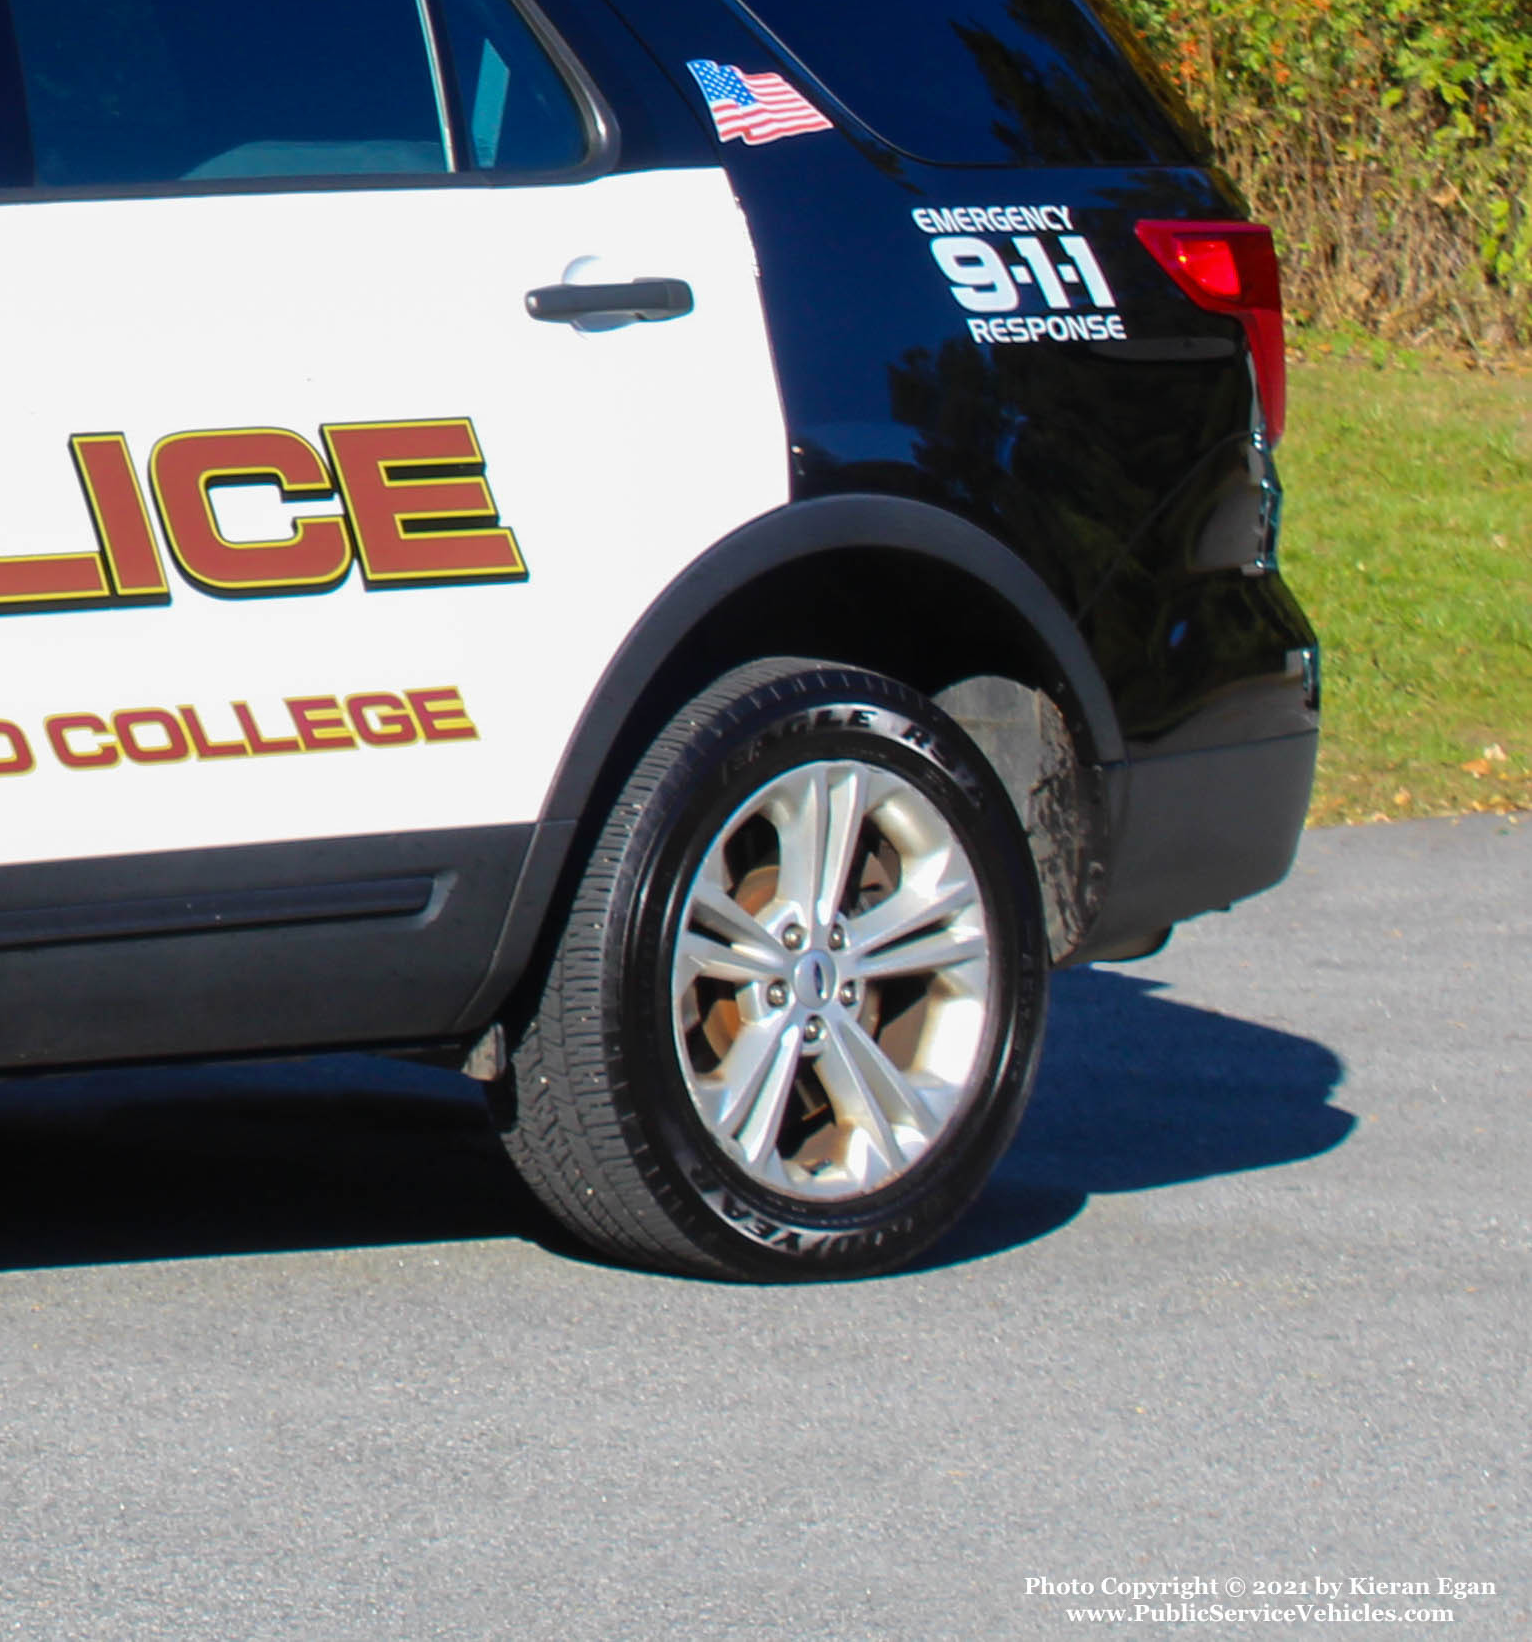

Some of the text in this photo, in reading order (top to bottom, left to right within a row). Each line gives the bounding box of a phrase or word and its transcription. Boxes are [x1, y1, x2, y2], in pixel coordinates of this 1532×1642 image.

[911, 206, 1074, 233] EMERGENCY
[966, 314, 1127, 343] RESPONSE
[43, 686, 480, 770] COLLEGE
